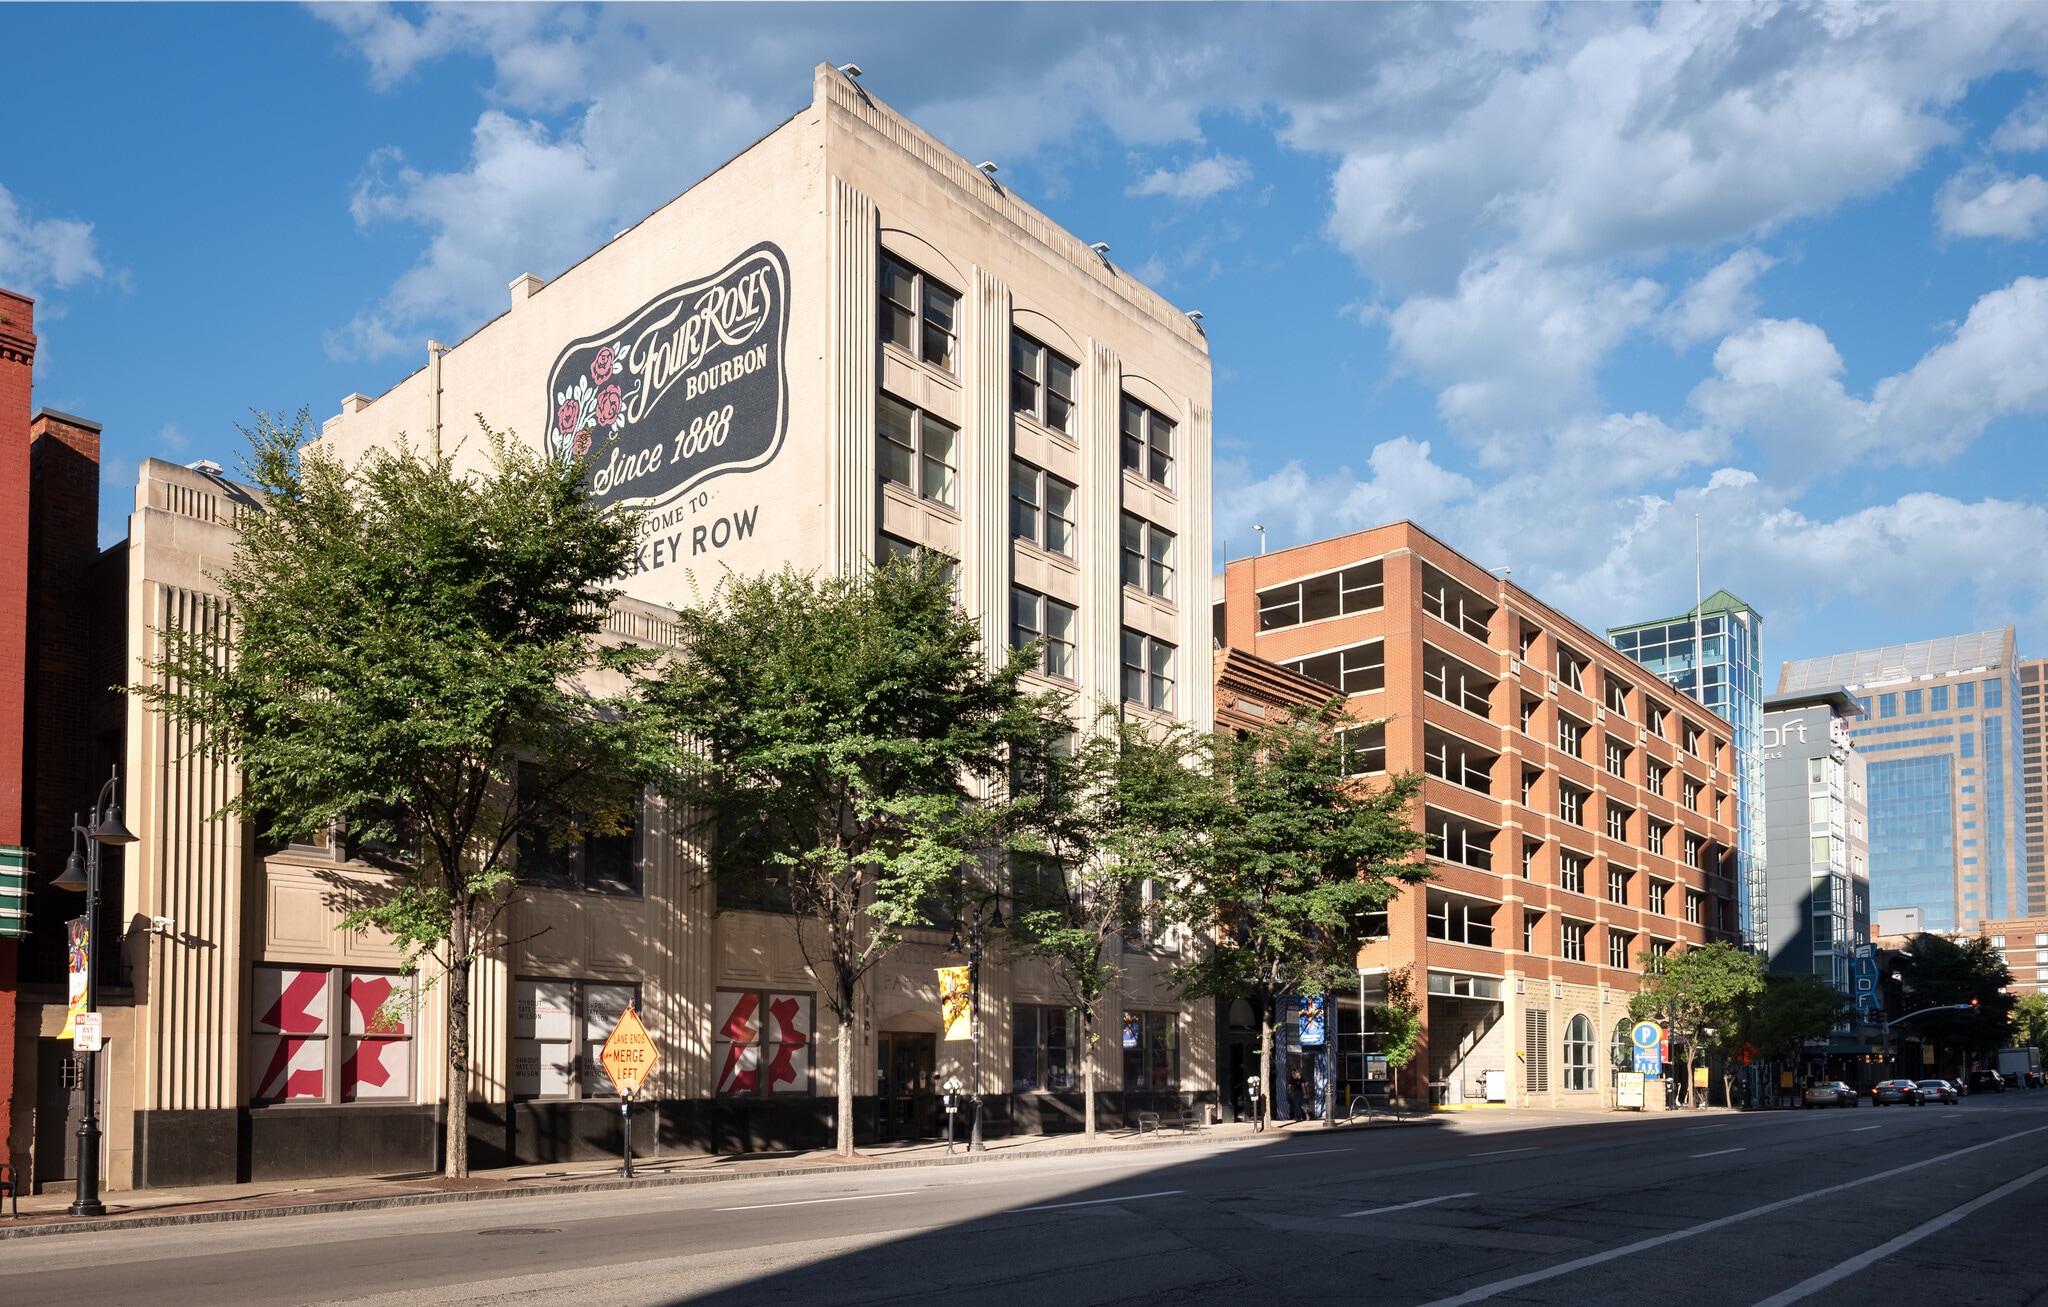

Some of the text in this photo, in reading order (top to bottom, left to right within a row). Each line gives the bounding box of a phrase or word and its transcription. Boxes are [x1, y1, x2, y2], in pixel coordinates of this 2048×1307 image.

[693, 266, 771, 364] ROSES
[686, 344, 769, 401] BOURBON
[594, 405, 734, 496] Since 1888
[633, 491, 708, 538] LCOME TO
[589, 505, 759, 587] SKEY ROW
[1763, 718, 1808, 749] oft
[82, 1035, 94, 1043] TIME
[613, 1034, 645, 1044] LANE ENDS
[613, 1049, 645, 1062] MERGE
[617, 1067, 638, 1080] LEFT
